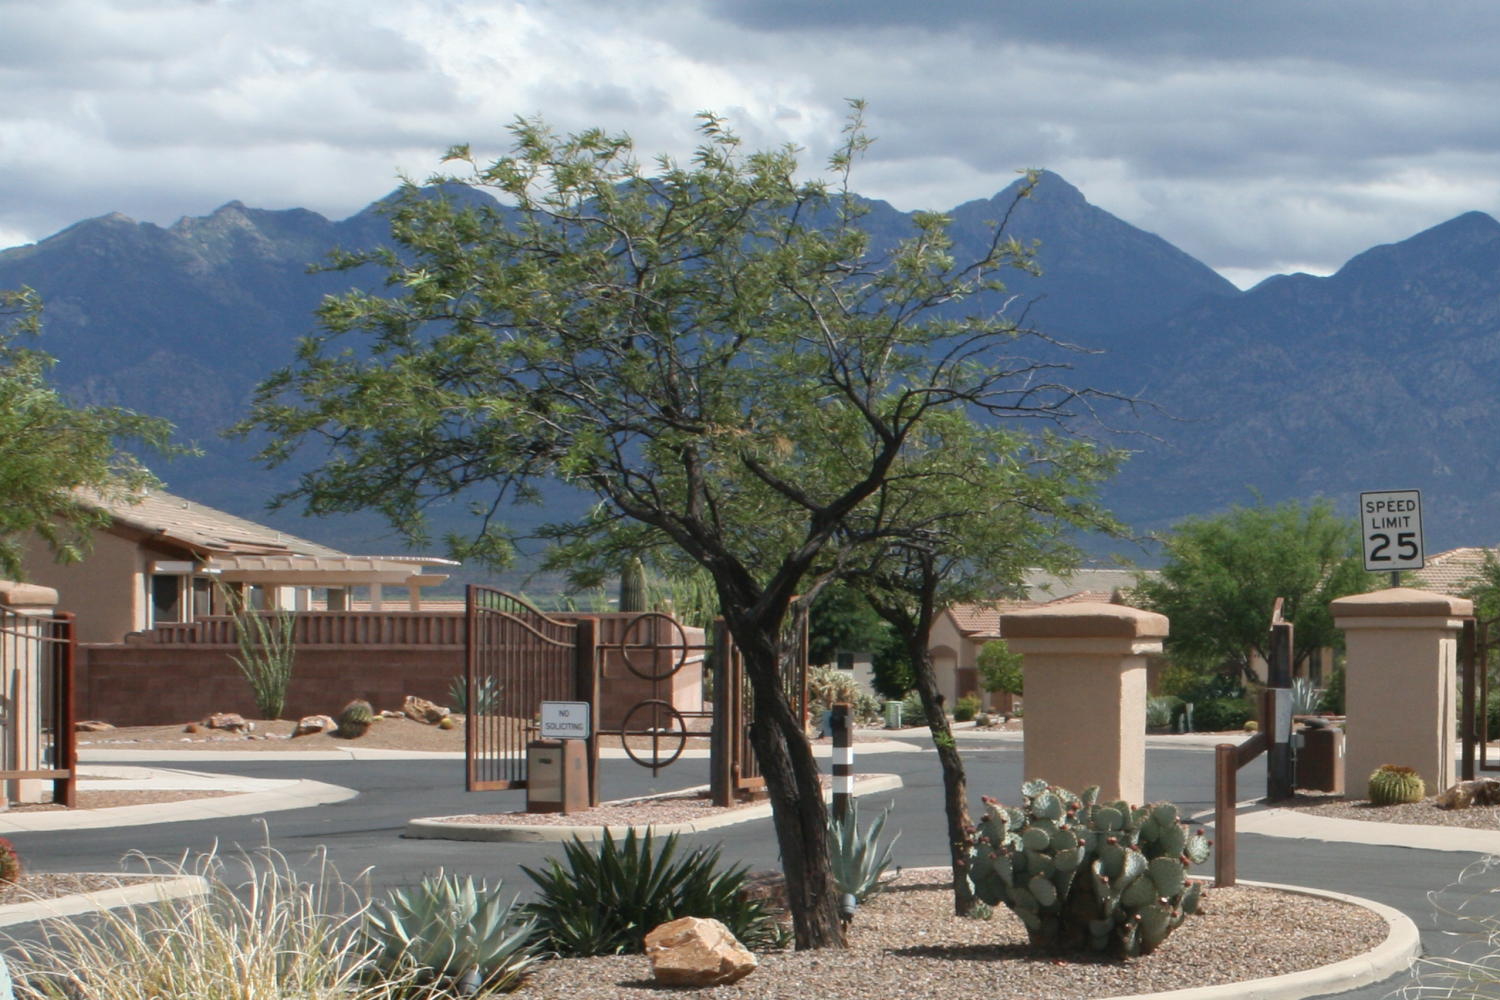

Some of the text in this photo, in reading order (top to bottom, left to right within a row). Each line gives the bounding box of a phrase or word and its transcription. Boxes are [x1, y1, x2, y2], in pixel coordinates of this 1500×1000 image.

[1365, 499, 1416, 514] SPEED
[1372, 516, 1411, 529] LIMIT
[1369, 532, 1419, 561] 25
[558, 709, 570, 717] NO
[545, 722, 584, 730] SOLICITING
